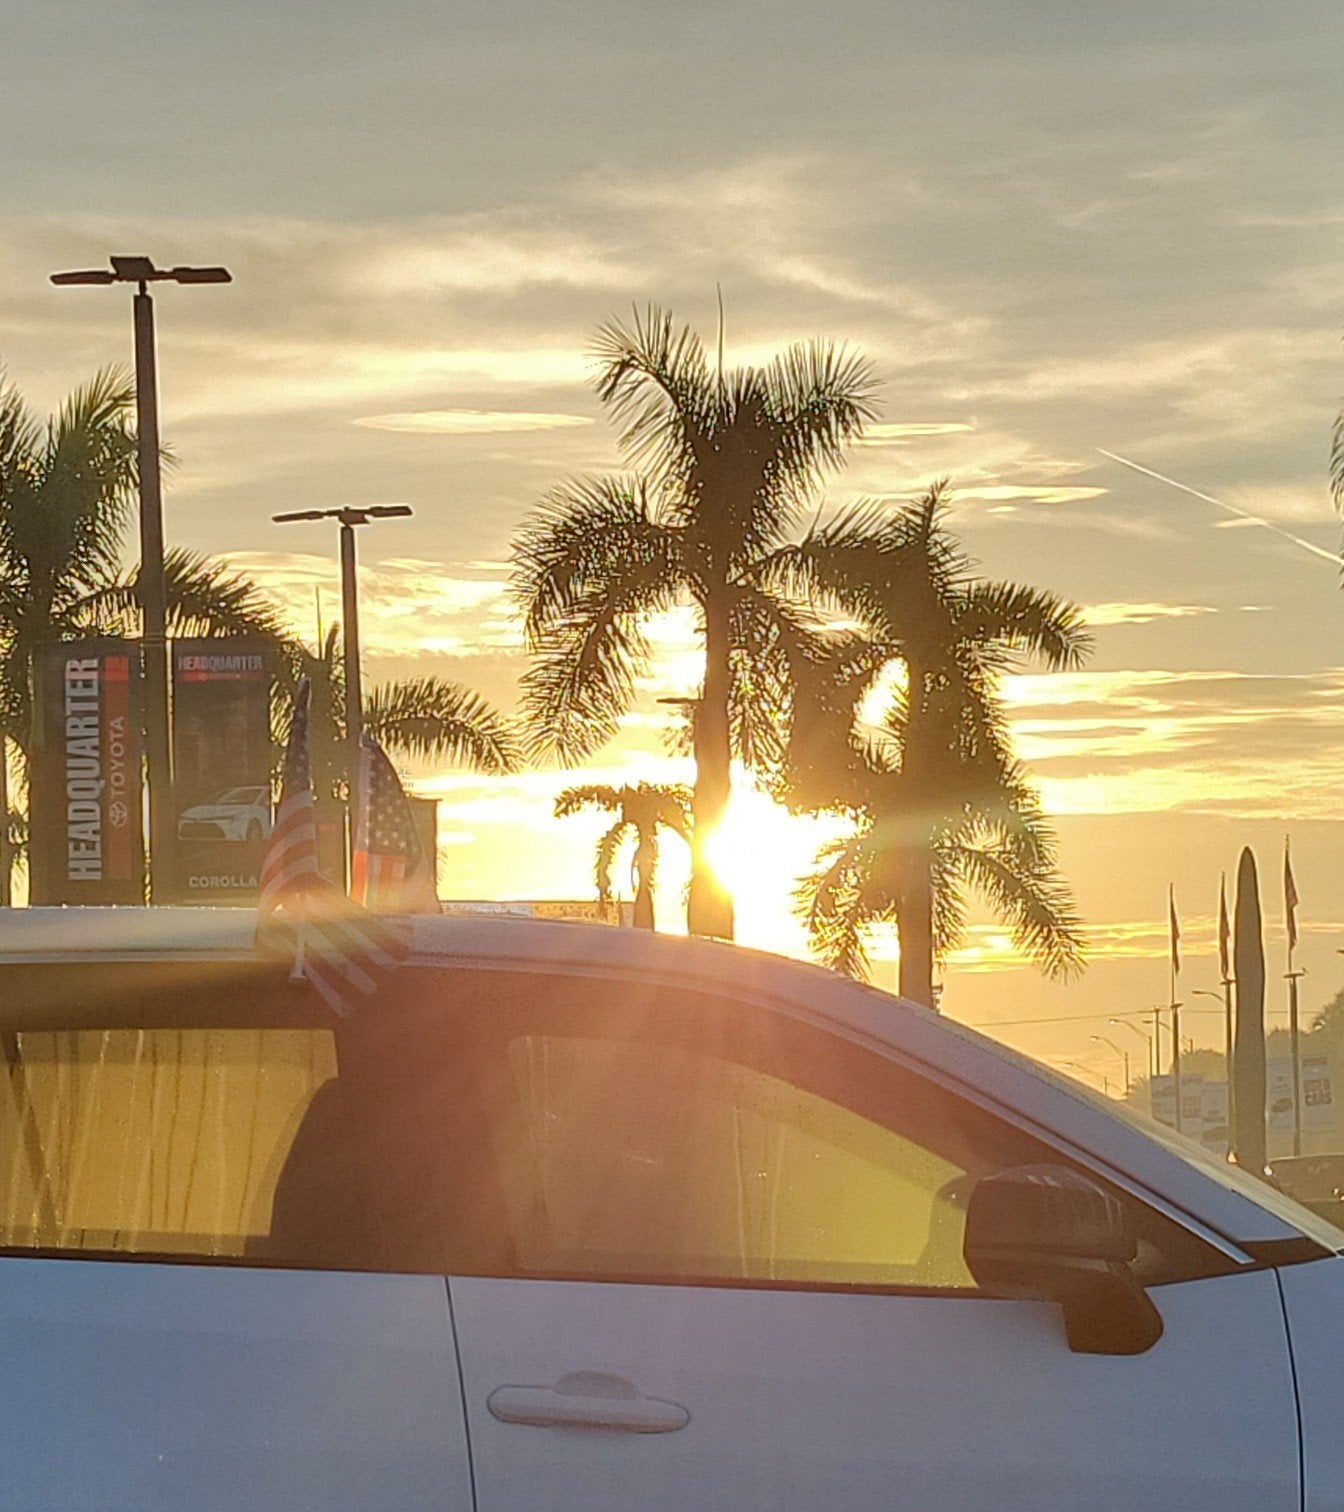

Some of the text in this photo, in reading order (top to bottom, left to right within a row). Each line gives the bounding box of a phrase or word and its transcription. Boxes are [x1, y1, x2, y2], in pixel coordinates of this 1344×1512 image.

[64, 657, 105, 882] HEADQUARTER
[108, 716, 126, 797] TOYOTA
[189, 876, 258, 888] COROLLA
